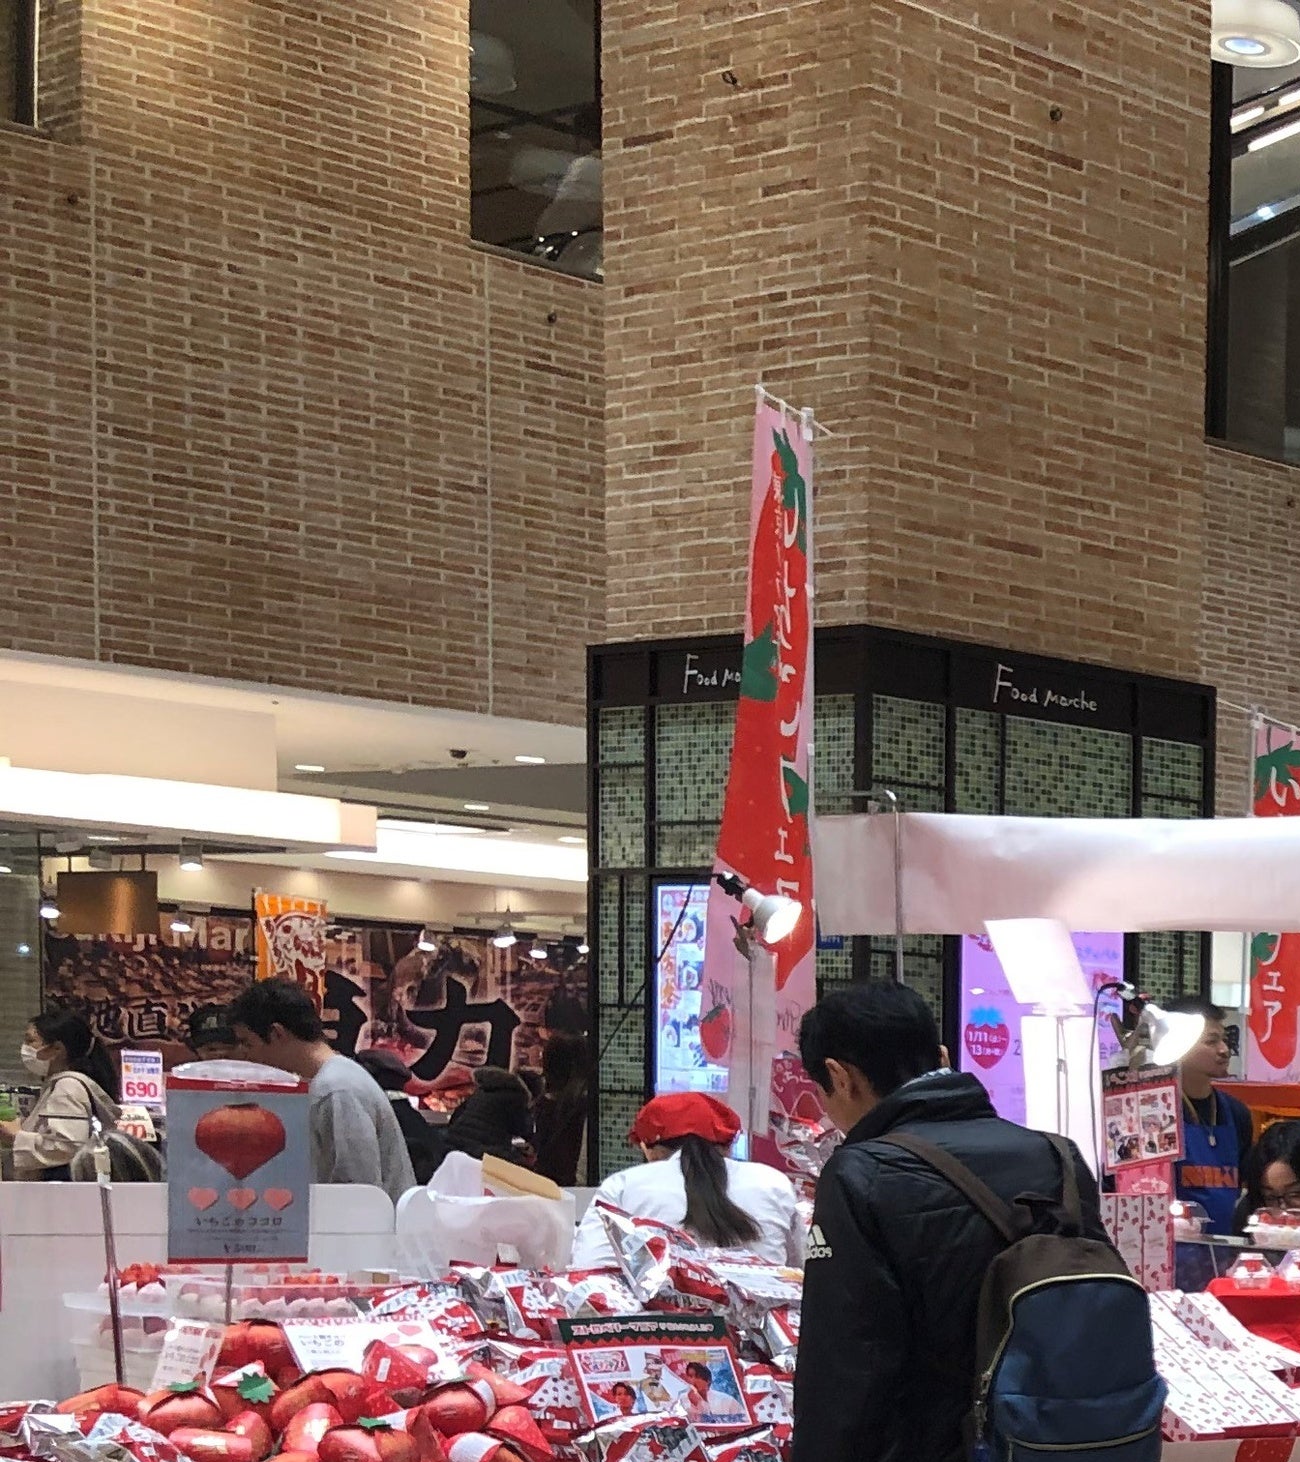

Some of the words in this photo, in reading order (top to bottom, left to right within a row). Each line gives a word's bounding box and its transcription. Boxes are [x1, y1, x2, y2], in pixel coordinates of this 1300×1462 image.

[683, 654, 718, 693] Food
[994, 664, 1038, 704] Food
[1043, 684, 1098, 711] Marche
[125, 1081, 158, 1098] 690
